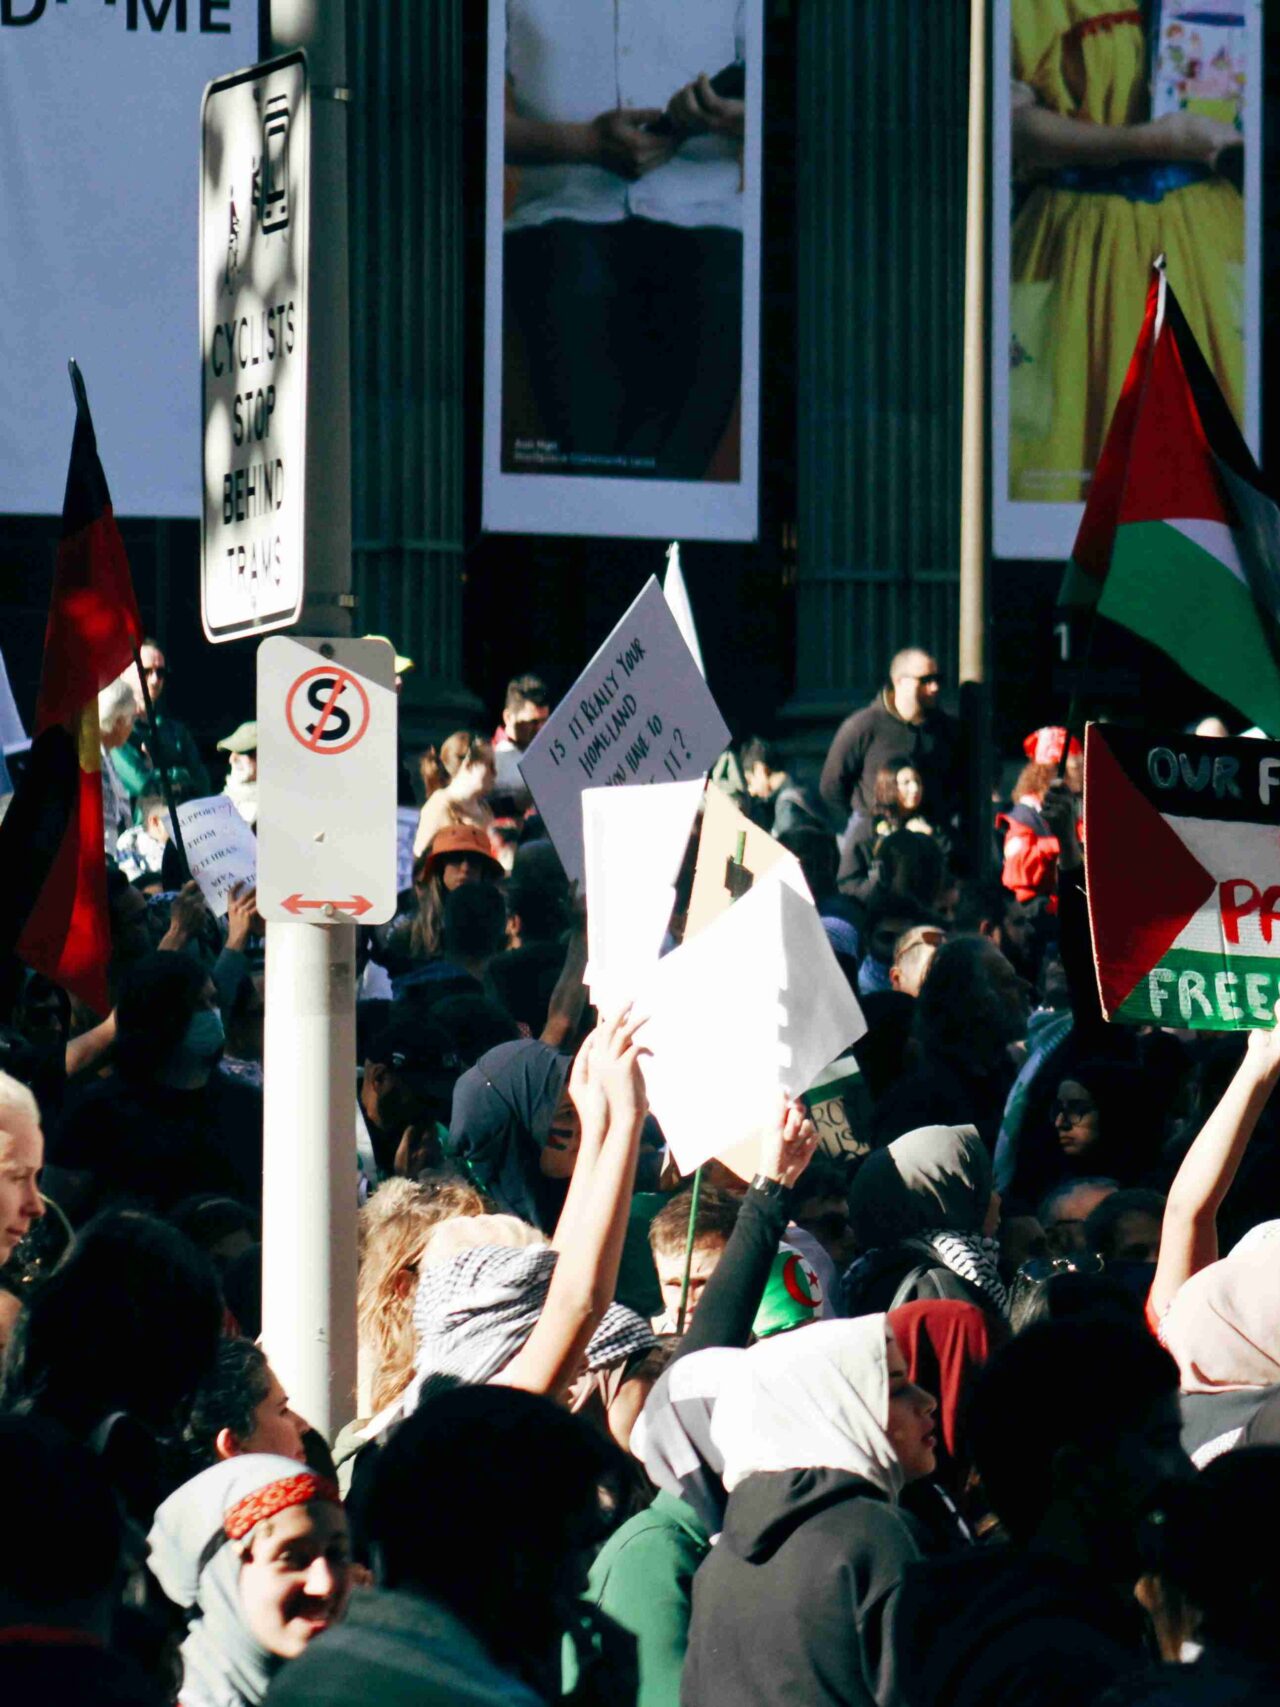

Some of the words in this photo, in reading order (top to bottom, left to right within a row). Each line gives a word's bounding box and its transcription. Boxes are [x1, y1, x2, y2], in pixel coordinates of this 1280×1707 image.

[211, 300, 295, 378] CYCLISTS
[232, 384, 276, 447] STOP
[222, 458, 285, 525] BEHIND
[226, 535, 282, 590] TRAMS
[549, 738, 567, 766] IS
[568, 716, 585, 741] IT
[580, 669, 620, 727] REALLY
[616, 636, 646, 677] YOUR
[578, 693, 637, 779] HOMELAND
[625, 733, 651, 775] HAVE
[1147, 746, 1242, 800] OUR
